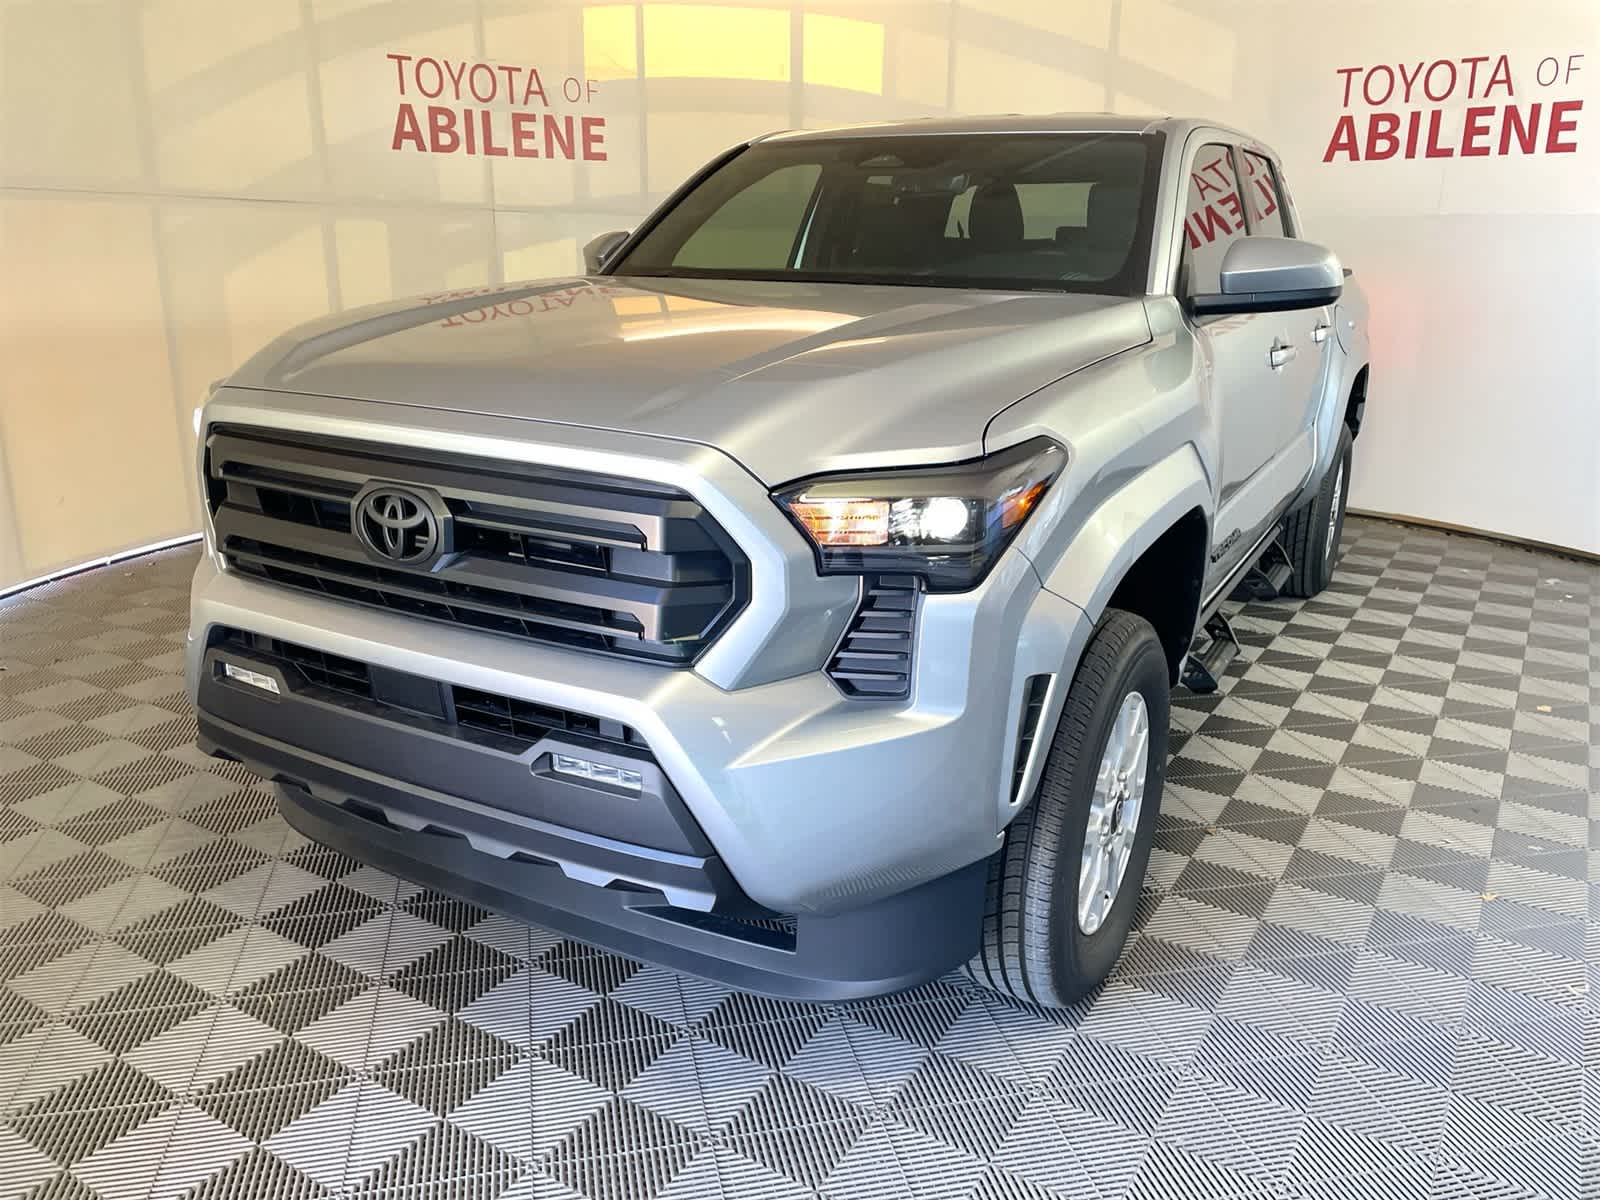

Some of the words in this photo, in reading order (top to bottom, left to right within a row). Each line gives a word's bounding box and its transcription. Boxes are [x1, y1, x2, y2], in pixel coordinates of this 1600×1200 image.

[386, 53, 549, 107] TOYOTA
[563, 77, 600, 104] OF
[1336, 54, 1514, 108] TOYOTA
[1536, 54, 1585, 87] OF
[391, 103, 608, 162] ABILENE
[1322, 99, 1584, 163] ABILENE
